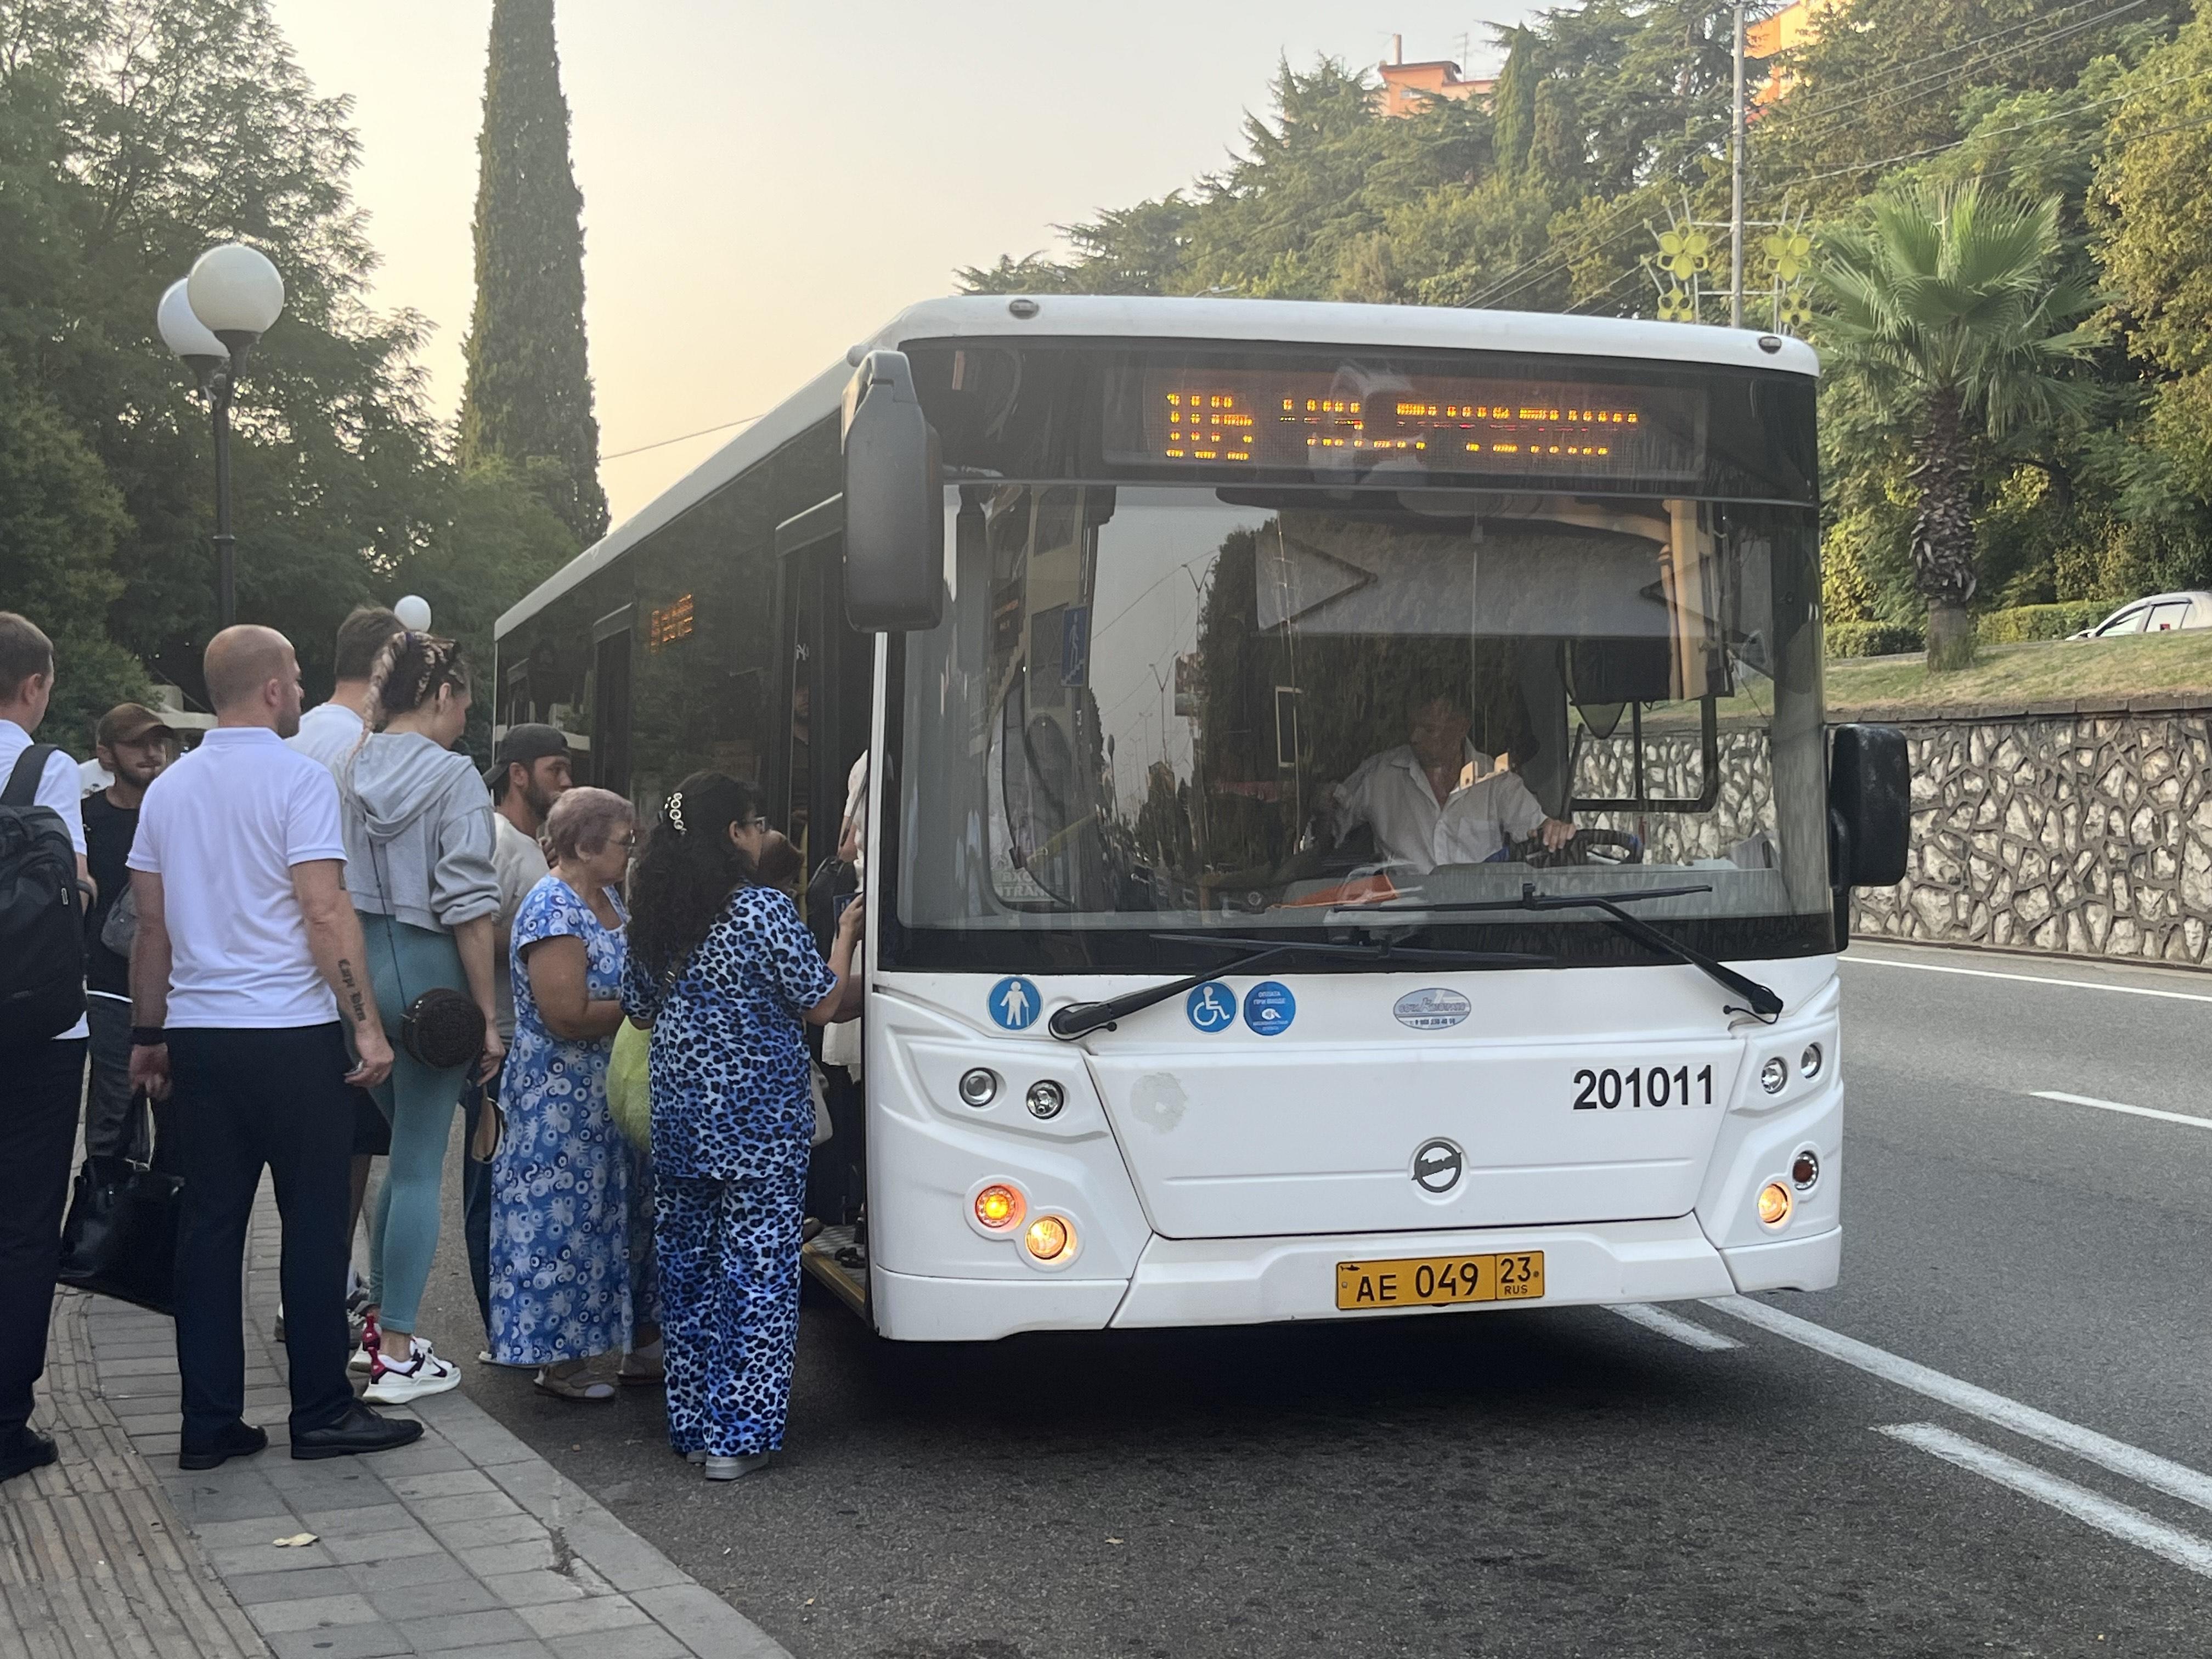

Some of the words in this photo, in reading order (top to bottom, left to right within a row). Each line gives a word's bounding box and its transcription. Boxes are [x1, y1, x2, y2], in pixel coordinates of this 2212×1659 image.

[1573, 1064, 1712, 1110] 201011
[1356, 1274, 1397, 1302] AE
[1415, 1262, 1479, 1298] 049
[1500, 1257, 1531, 1284] 23
[1504, 1284, 1528, 1296] RUS
